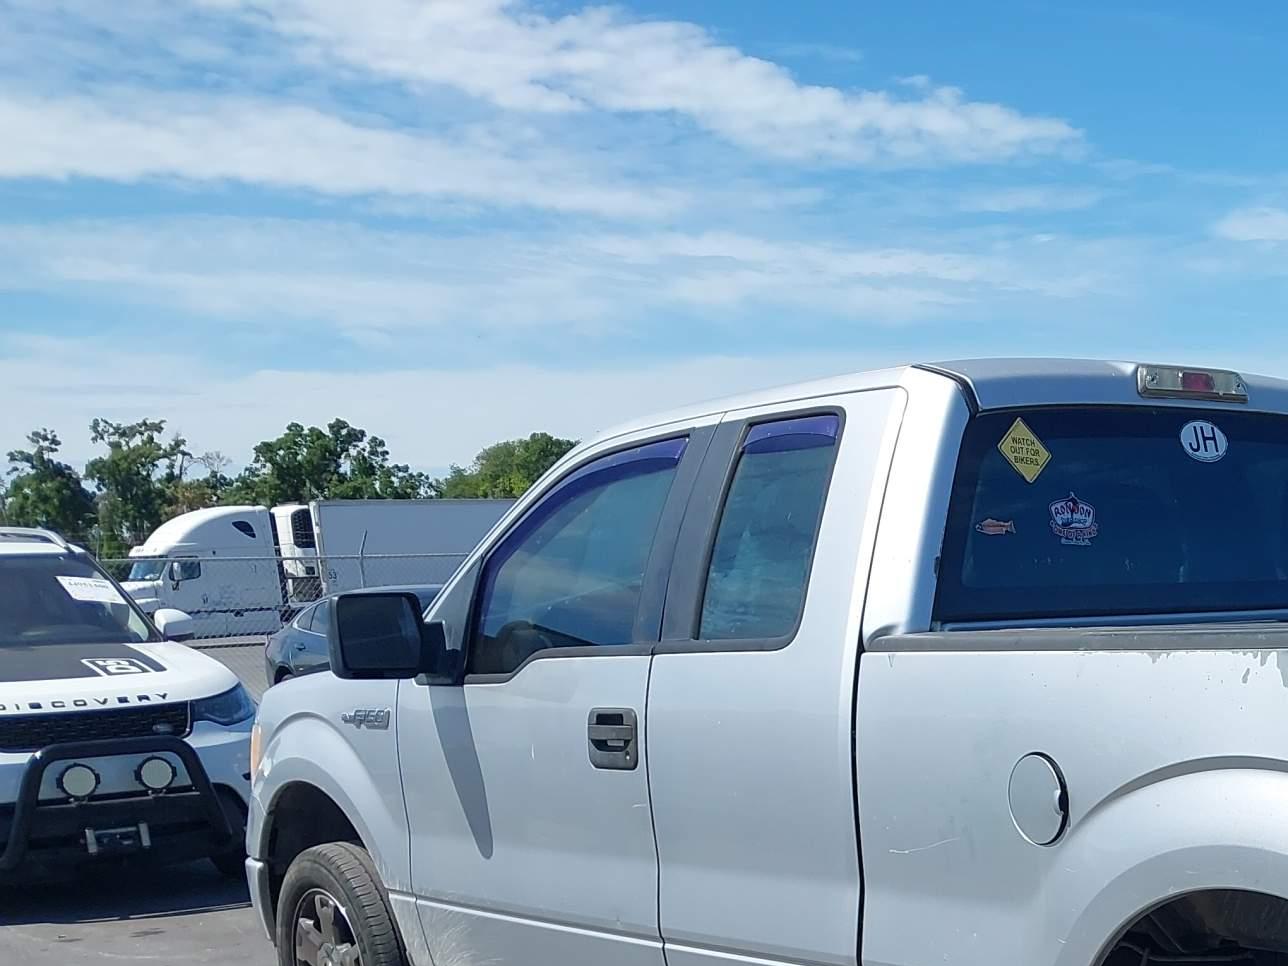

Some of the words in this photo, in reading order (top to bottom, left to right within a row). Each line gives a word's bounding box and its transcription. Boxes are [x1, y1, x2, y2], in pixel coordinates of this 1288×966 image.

[1011, 436, 1036, 447] WATCH
[1189, 426, 1219, 453] JH
[1010, 446, 1024, 455] OUT
[1026, 448, 1040, 457] FOR
[1013, 455, 1040, 467] BIKERS
